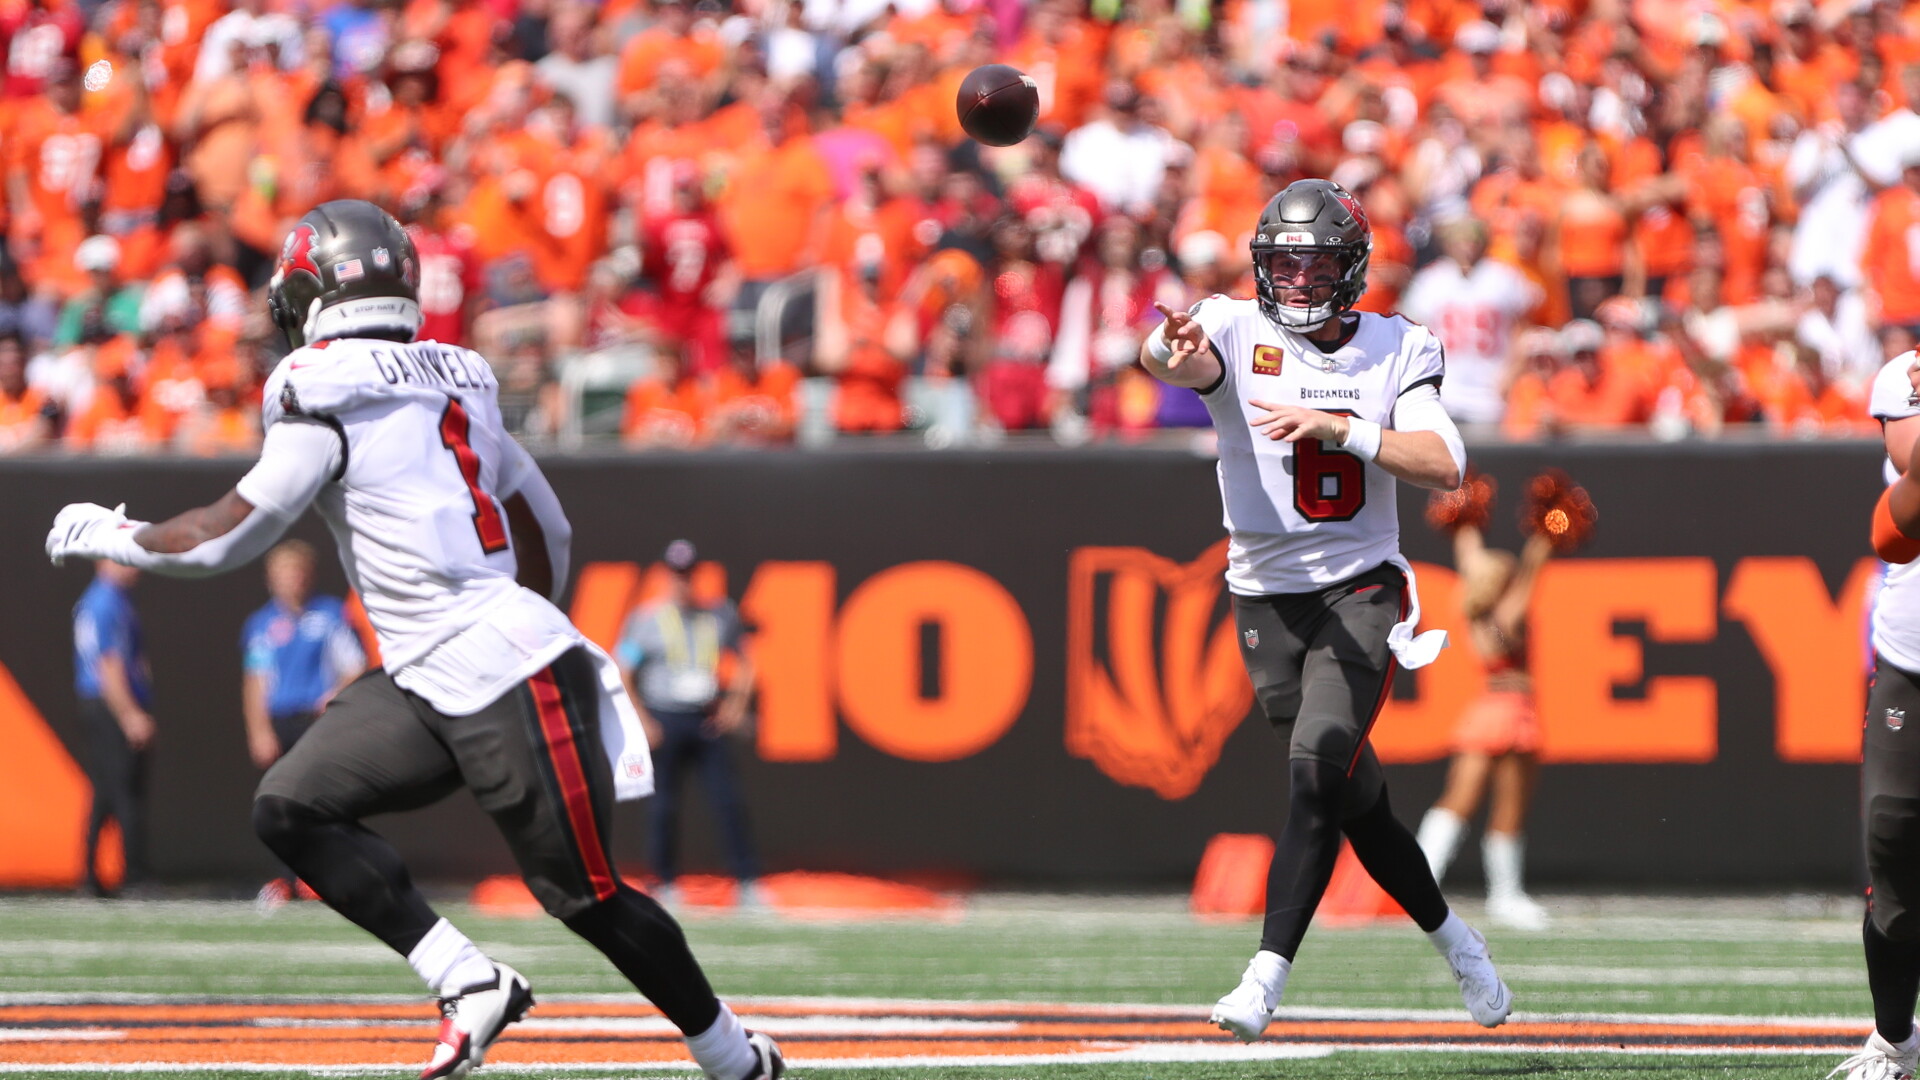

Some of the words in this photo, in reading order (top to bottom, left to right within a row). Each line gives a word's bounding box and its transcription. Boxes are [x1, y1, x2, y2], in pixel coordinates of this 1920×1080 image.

[1255, 346, 1281, 368] C
[1300, 387, 1360, 400] BUCCANEERS
[438, 395, 510, 556] 1
[1292, 408, 1367, 523] 6
